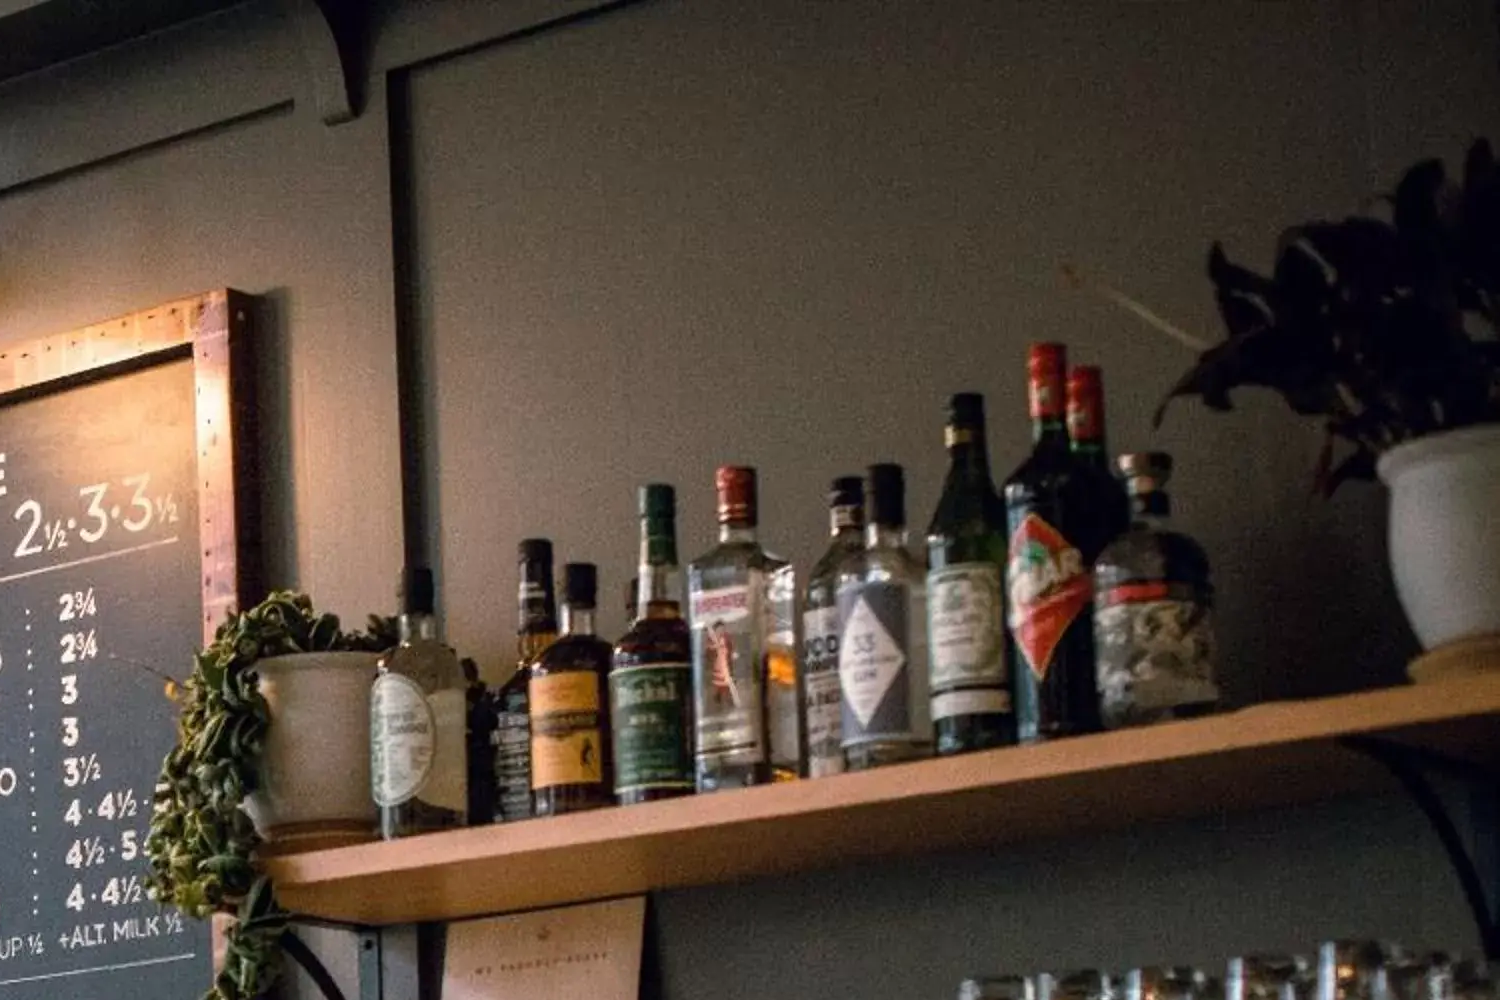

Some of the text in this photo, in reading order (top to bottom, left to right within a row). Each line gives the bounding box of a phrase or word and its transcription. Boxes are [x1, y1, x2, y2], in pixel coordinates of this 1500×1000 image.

[61, 674, 78, 704] 3
[62, 717, 79, 747] 3
[112, 916, 160, 942] MILK
